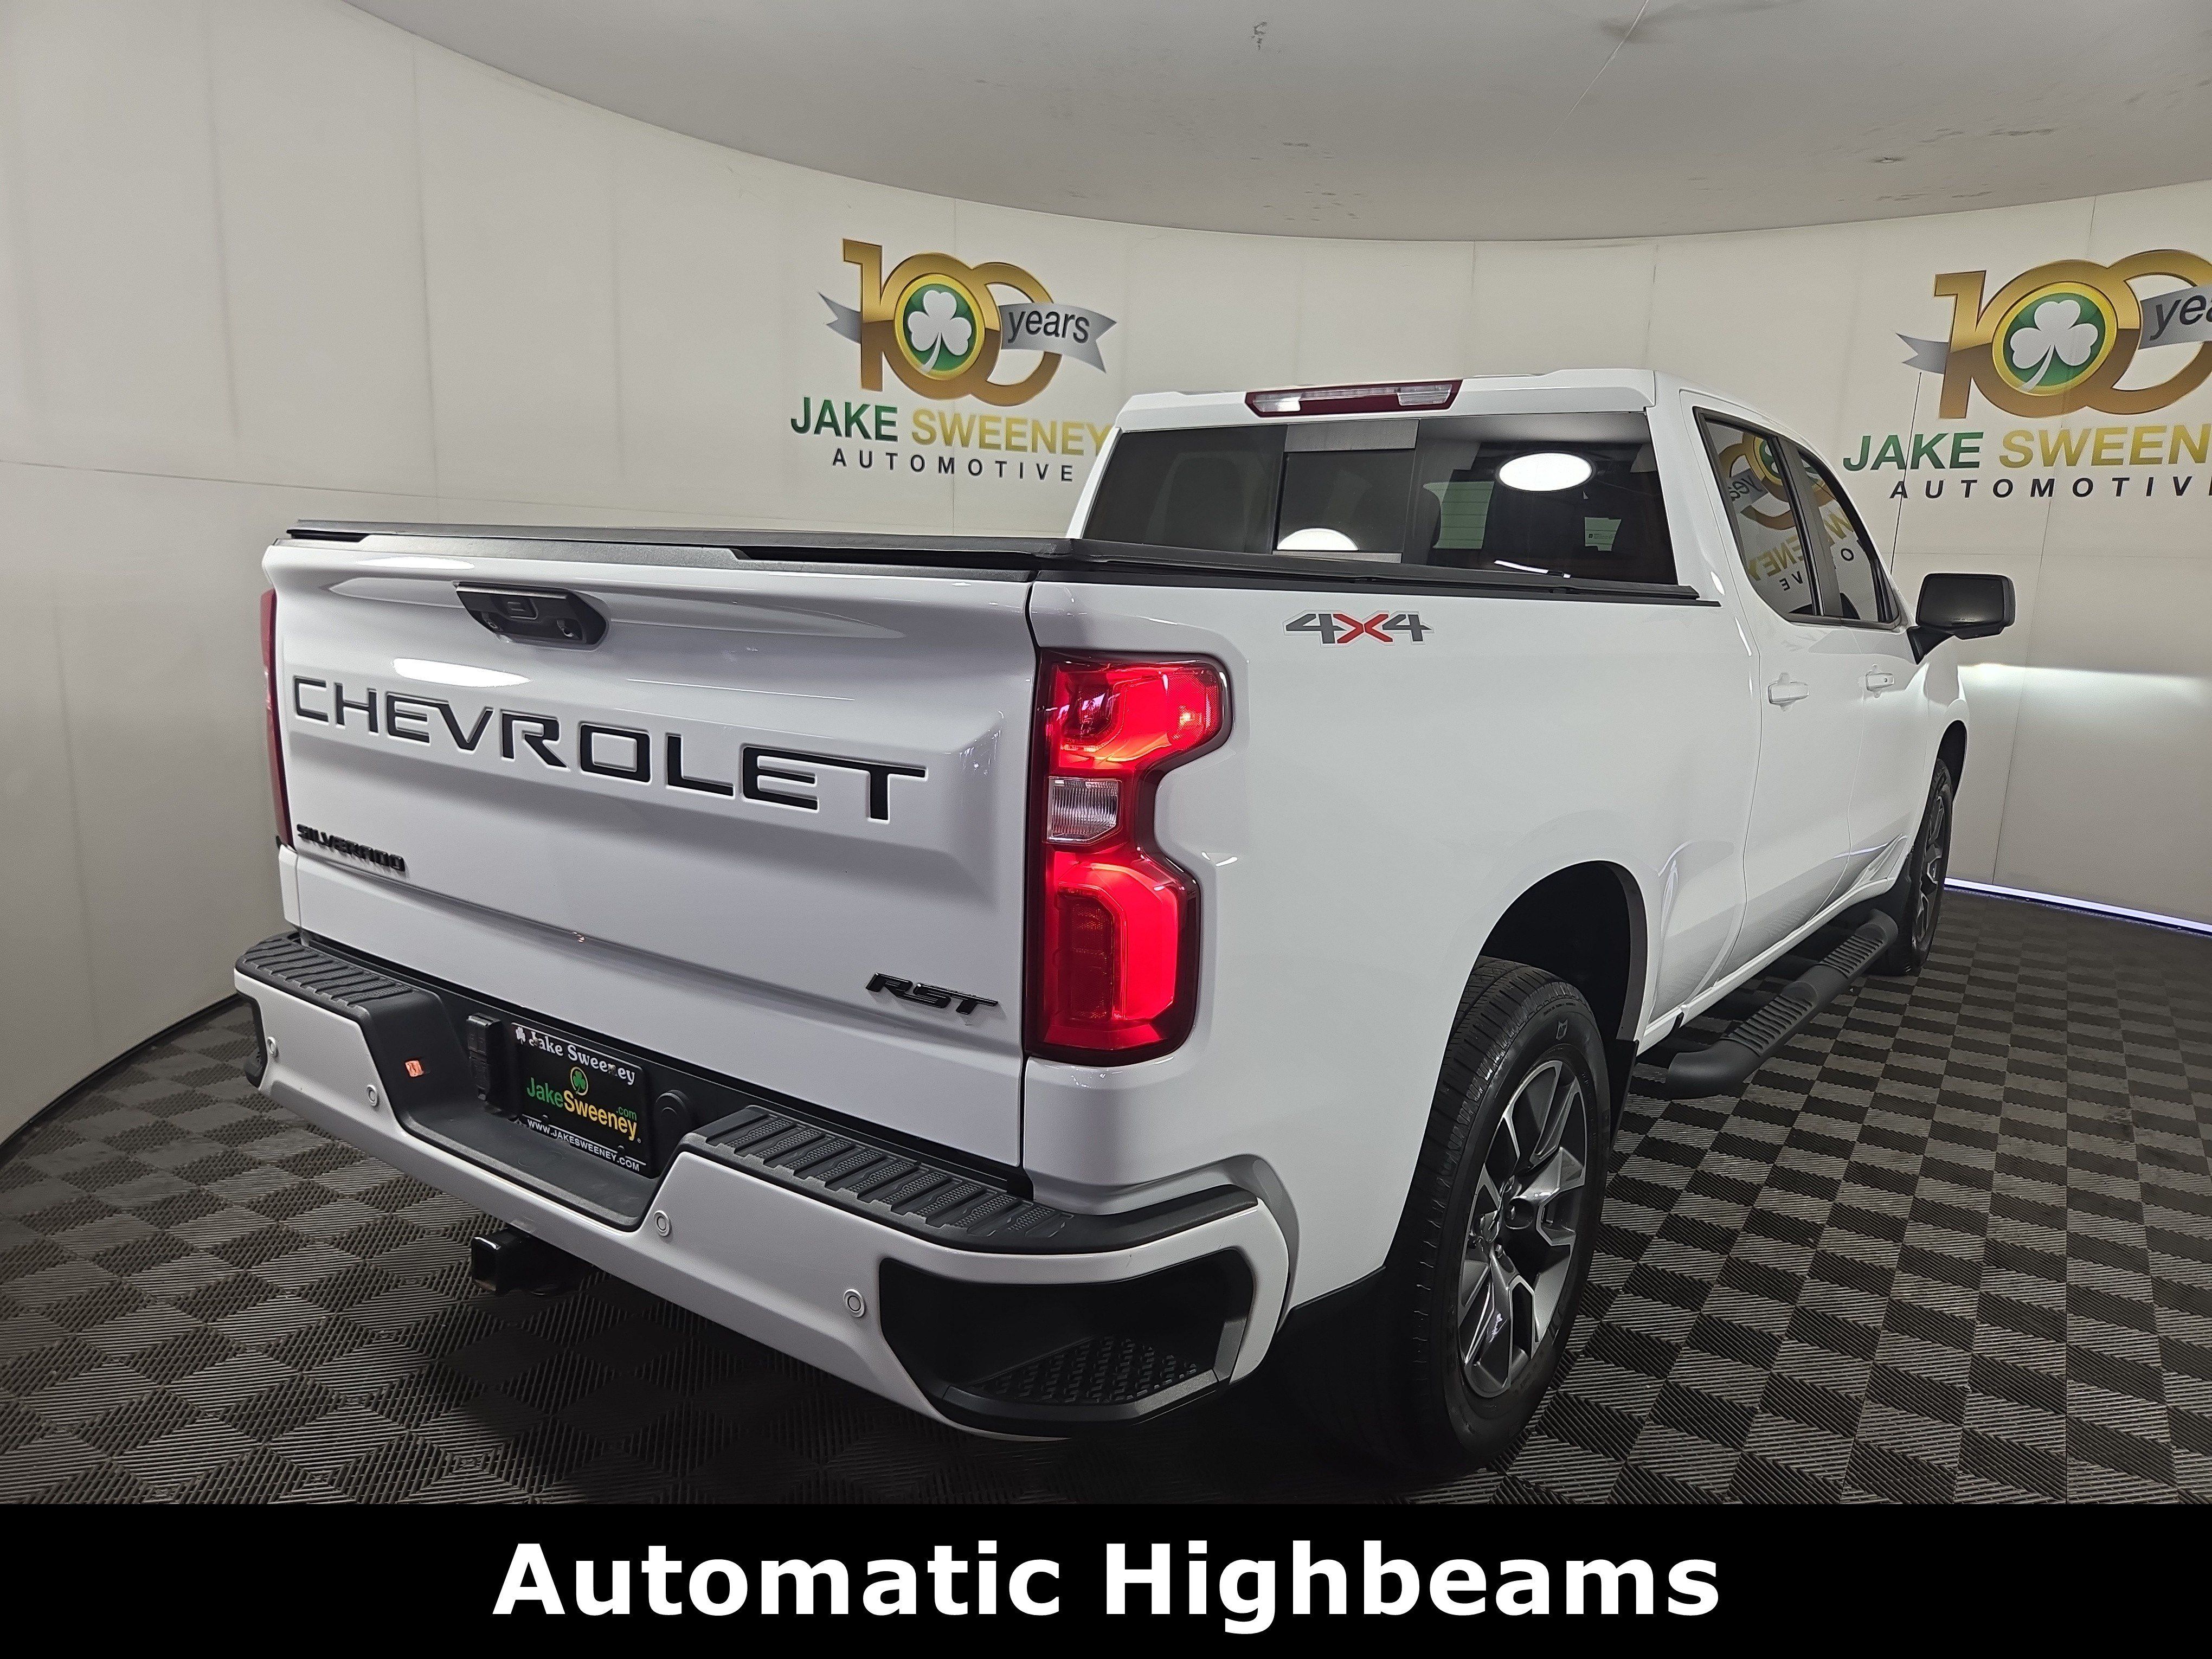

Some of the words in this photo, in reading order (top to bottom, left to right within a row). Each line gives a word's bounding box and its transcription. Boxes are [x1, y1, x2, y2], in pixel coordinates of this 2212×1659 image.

[843, 239, 1062, 407] 100
[1007, 309, 1090, 343] years
[791, 397, 898, 442] JAKE
[912, 409, 1112, 456] SWEENEY
[832, 448, 1073, 482] AUTOMOTIVE
[1843, 431, 1984, 472] JAKE
[1889, 476, 2212, 499] AUTOMOTIV
[294, 676, 926, 822] CHEVROLET
[297, 824, 406, 872] SILVERADO
[866, 973, 999, 1014] RST
[527, 1118, 640, 1172] WWW.JAKESWEENEY.COM
